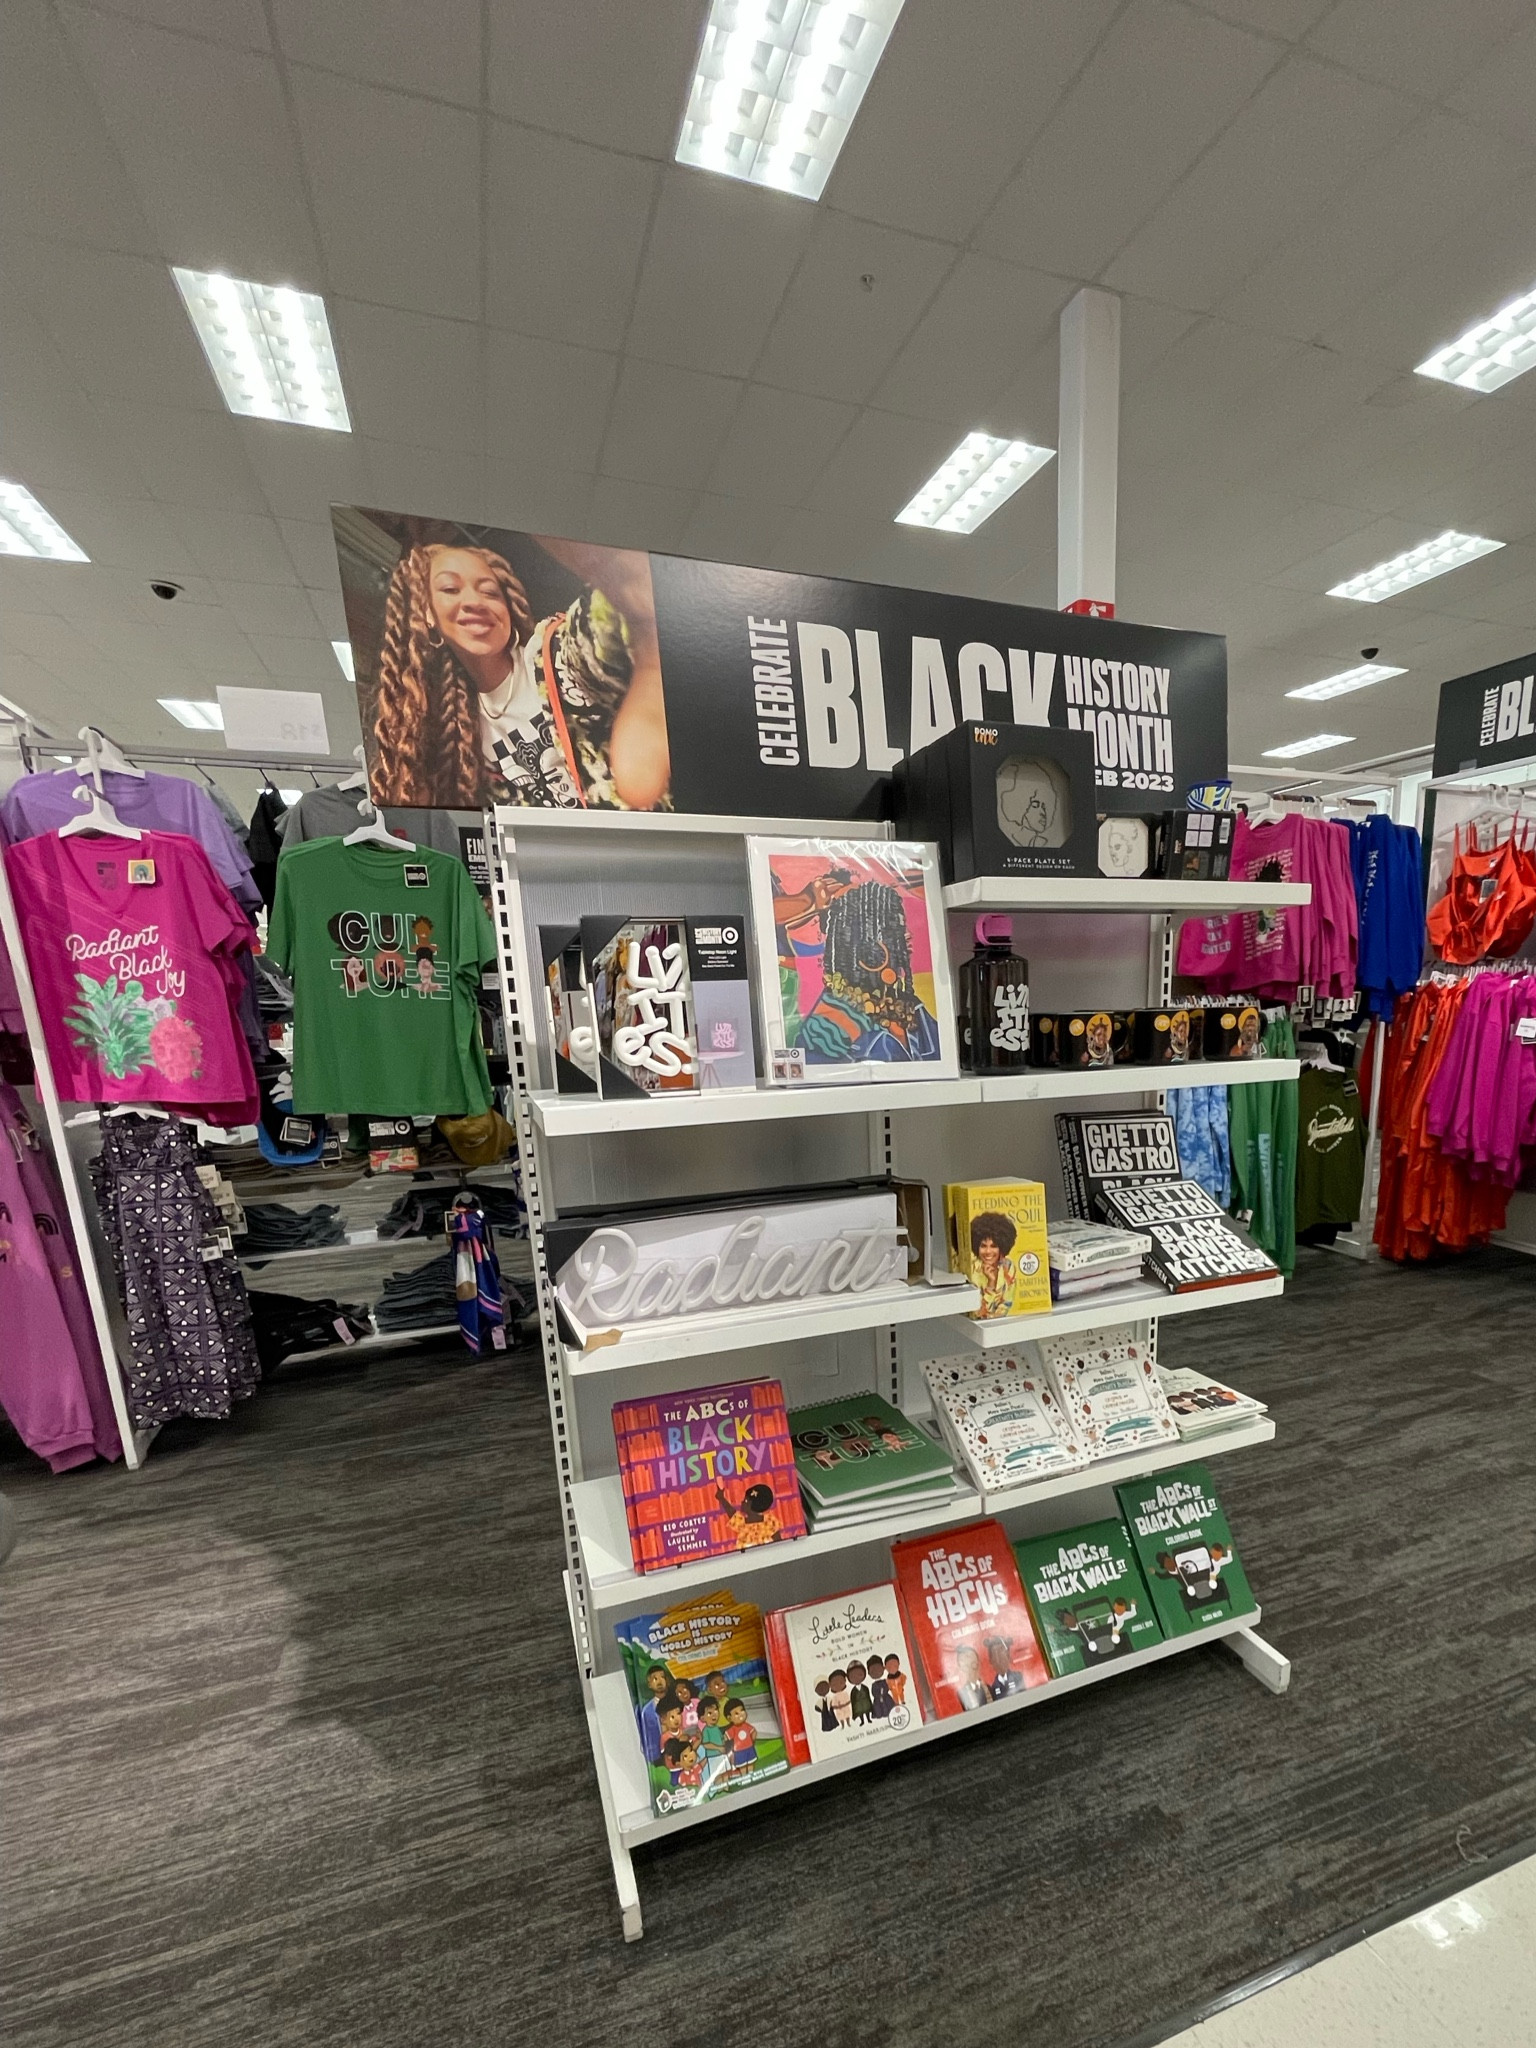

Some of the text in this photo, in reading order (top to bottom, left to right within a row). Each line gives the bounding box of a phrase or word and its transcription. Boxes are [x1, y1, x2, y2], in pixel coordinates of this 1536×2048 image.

[747, 616, 800, 767] CELEBRATE
[797, 622, 1057, 772] BLACK
[1063, 655, 1170, 715] HISTORY
[1479, 685, 1499, 746] CELEBRATE
[1496, 675, 1536, 743] BL
[1095, 769, 1174, 792] EB 2023
[66, 925, 159, 961] Radiant
[109, 945, 172, 981] Black
[156, 969, 185, 997] Joy
[1086, 1122, 1169, 1149] GHETTO
[1090, 1145, 1173, 1172] GASTRO
[1072, 1145, 1082, 1174] BLACK
[1078, 1175, 1087, 1206] POWER
[972, 1194, 1044, 1210] FEEDING THE
[1113, 1183, 1204, 1208] GHETTO
[1007, 1208, 1045, 1224] SOUL
[1126, 1199, 1215, 1224] GASTRO
[1149, 1218, 1231, 1244] BLACK
[1161, 1234, 1250, 1261] POWER
[572, 1216, 908, 1322] Radiant
[1019, 1289, 1049, 1298] BROWN
[664, 1398, 749, 1423] THE ABCs OF
[667, 1414, 754, 1455] BLACK
[658, 1441, 767, 1489] HISTORY
[1139, 1499, 1158, 1514] THE
[1191, 1485, 1201, 1497] OF
[663, 1516, 706, 1532] RIO CORTEZ
[1134, 1498, 1216, 1537] BLACK WALL ST
[667, 1534, 695, 1547] LAUREN
[678, 1540, 707, 1552] SEMMER
[1165, 1528, 1203, 1546] COLORING BOOK
[928, 1548, 947, 1562] THE
[977, 1555, 993, 1574] OF
[1040, 1562, 1061, 1579] THE
[1098, 1545, 1109, 1558] OF
[1033, 1559, 1125, 1603] BLACK WALL ST
[648, 1616, 741, 1644] BLACK HISTORY
[692, 1629, 701, 1638] IS
[808, 1603, 884, 1645] Little Leaders
[831, 1630, 868, 1644] BOLD WOMEN
[660, 1631, 733, 1653] WORLD HISTORY
[831, 1646, 873, 1662] BLACK HISTORY
